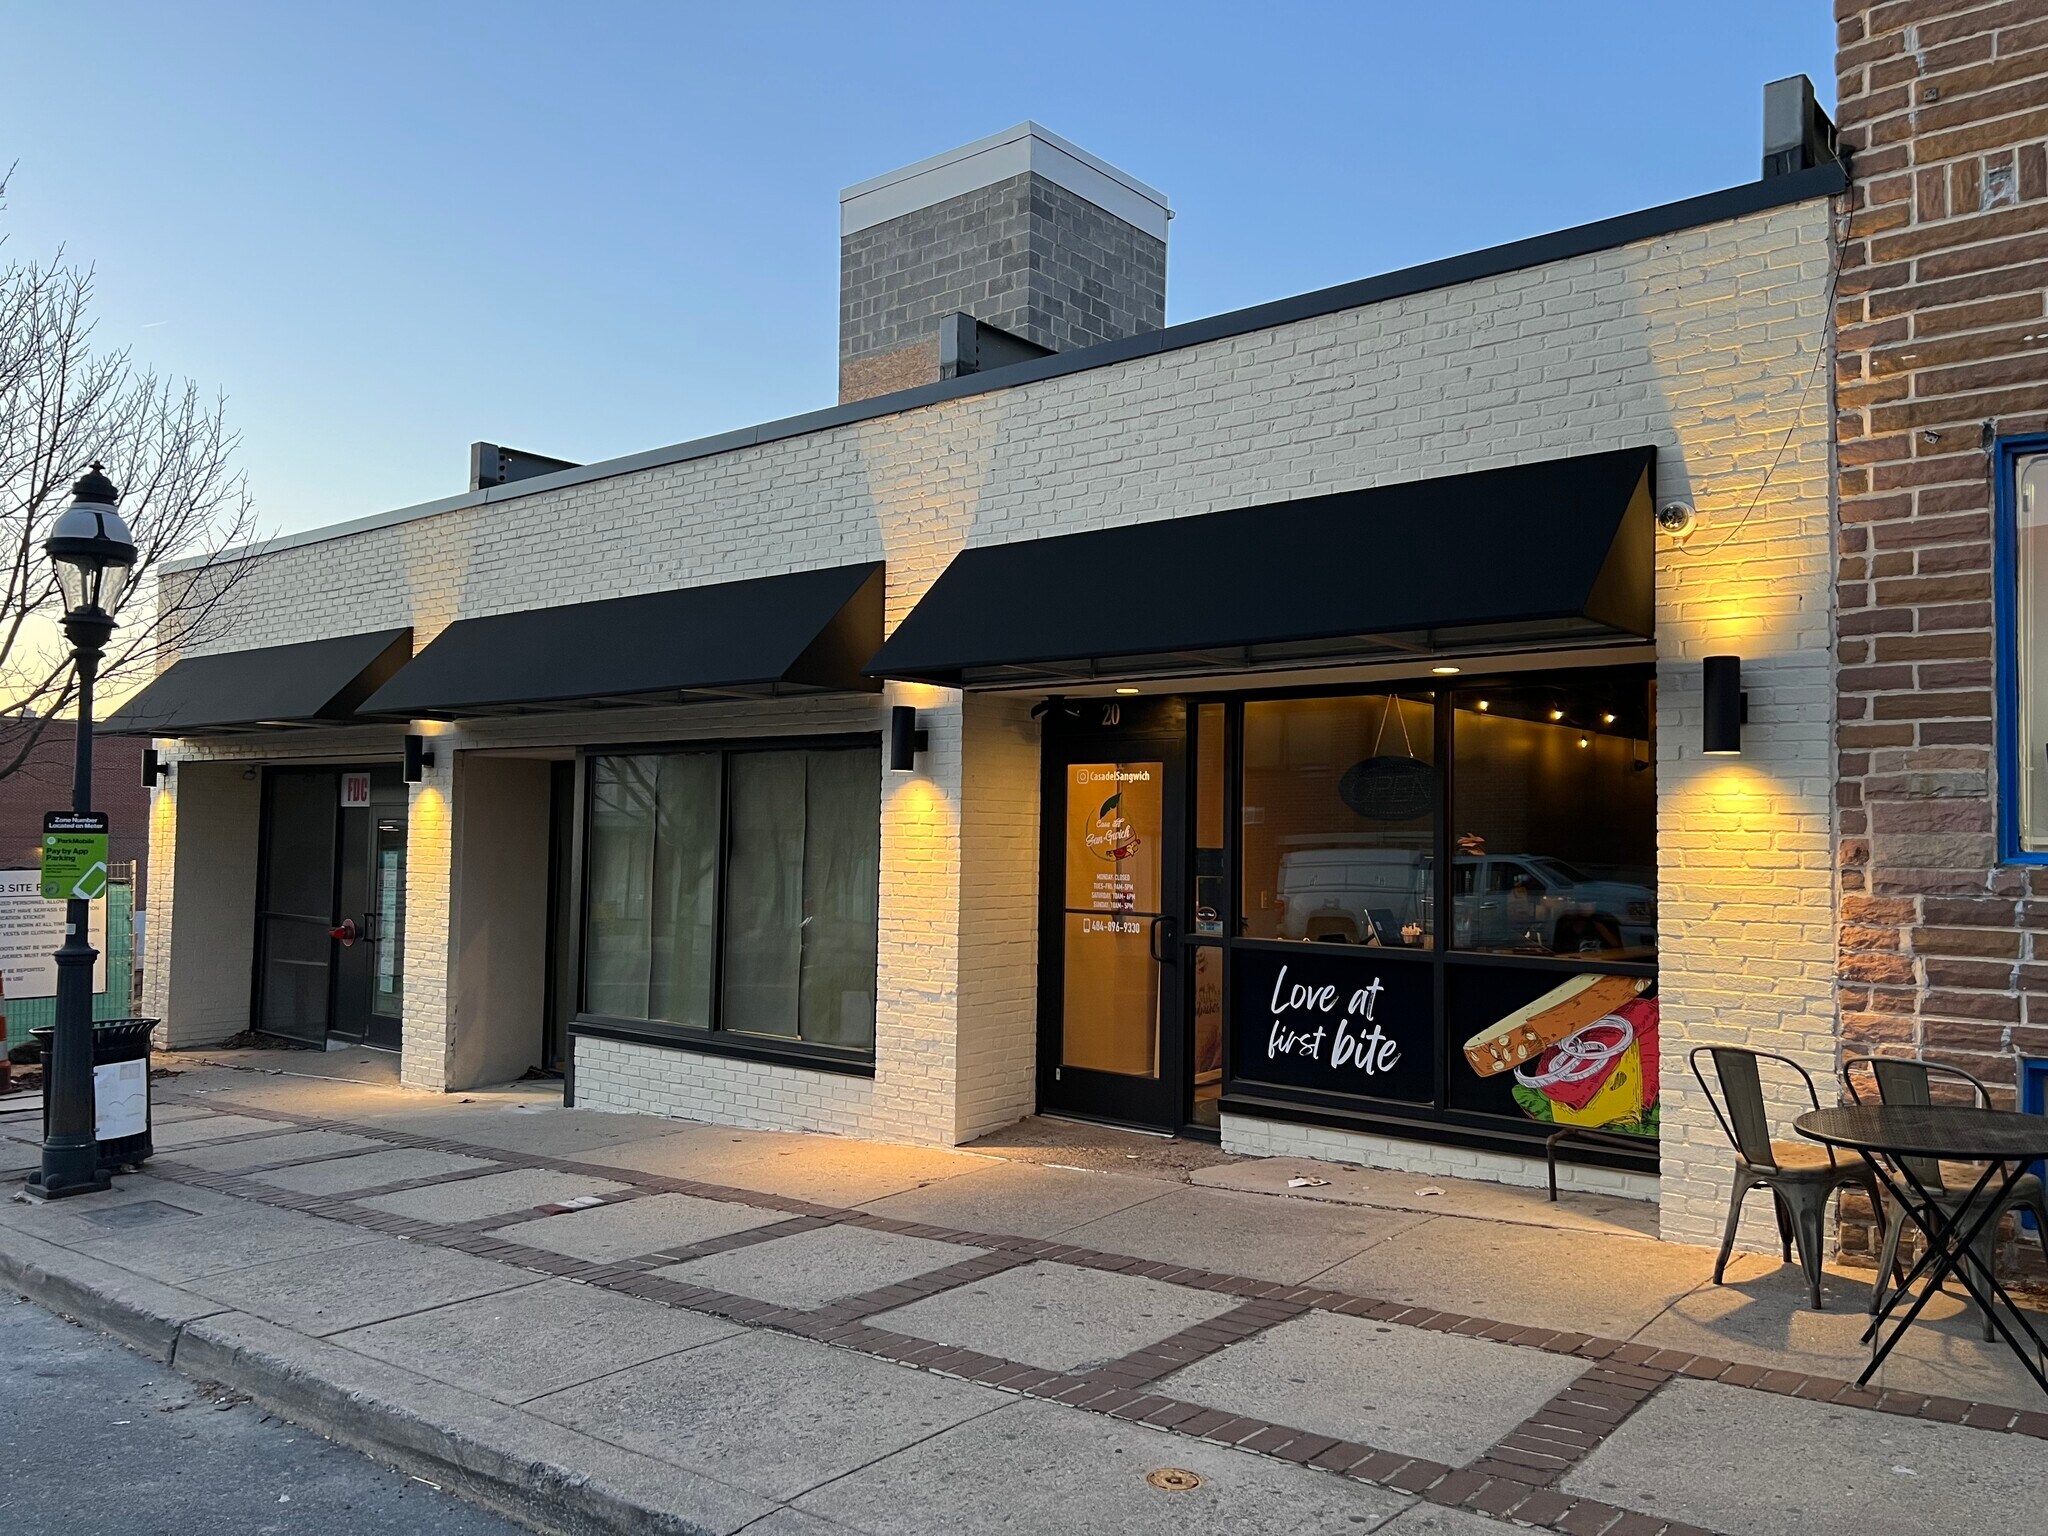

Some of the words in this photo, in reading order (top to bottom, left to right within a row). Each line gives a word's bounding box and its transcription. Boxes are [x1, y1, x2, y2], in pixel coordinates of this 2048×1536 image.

[1102, 703, 1120, 726] 20
[1090, 771, 1150, 783] CasadelSangwich
[347, 777, 368, 802] FDC
[1096, 820, 1110, 828] Casa
[8, 884, 32, 892] SITE
[1092, 920, 1140, 934] 484-896-9330
[1271, 965, 1339, 1014] Love
[1348, 977, 1384, 1021] at
[1268, 1020, 1326, 1059] first
[1331, 1019, 1402, 1075] bite
